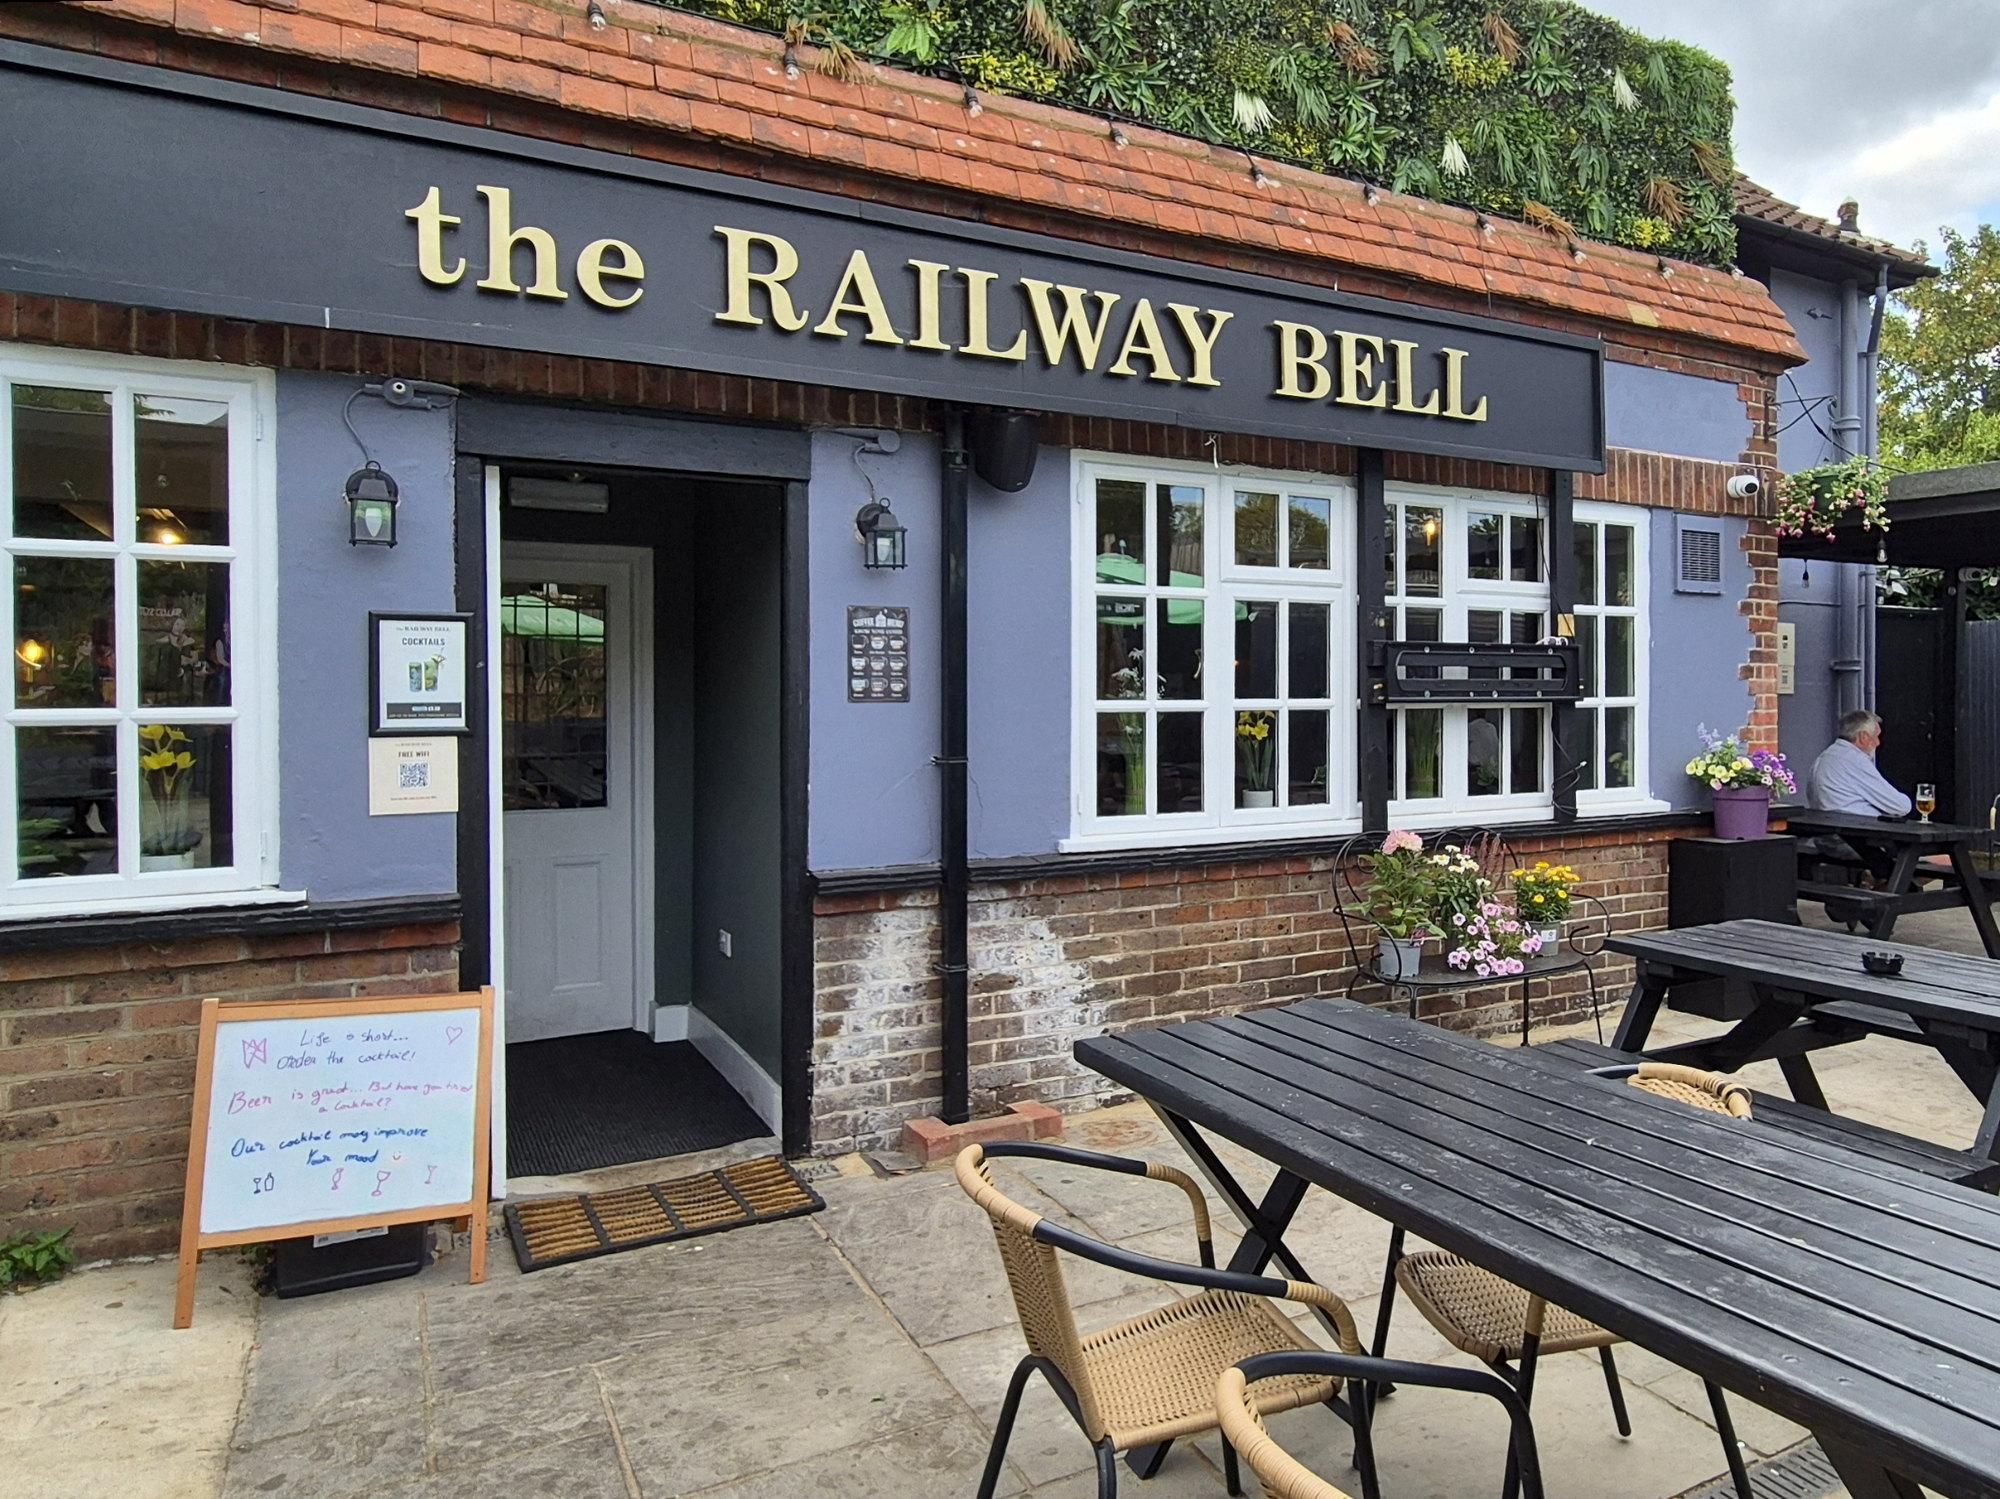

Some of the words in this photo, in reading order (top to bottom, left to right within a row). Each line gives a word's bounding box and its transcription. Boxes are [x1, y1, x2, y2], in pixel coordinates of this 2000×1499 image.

[405, 184, 645, 309] the
[713, 224, 1235, 387] RAILWAY
[1273, 319, 1488, 422] BELL
[401, 637, 446, 646] COCKTAILS
[300, 1028, 332, 1047] Life
[326, 1050, 344, 1065] the
[227, 1090, 272, 1115] Beer
[291, 1088, 304, 1100] is
[231, 1137, 267, 1157] Our
[374, 1127, 429, 1139] improve
[344, 1149, 380, 1164] mood
